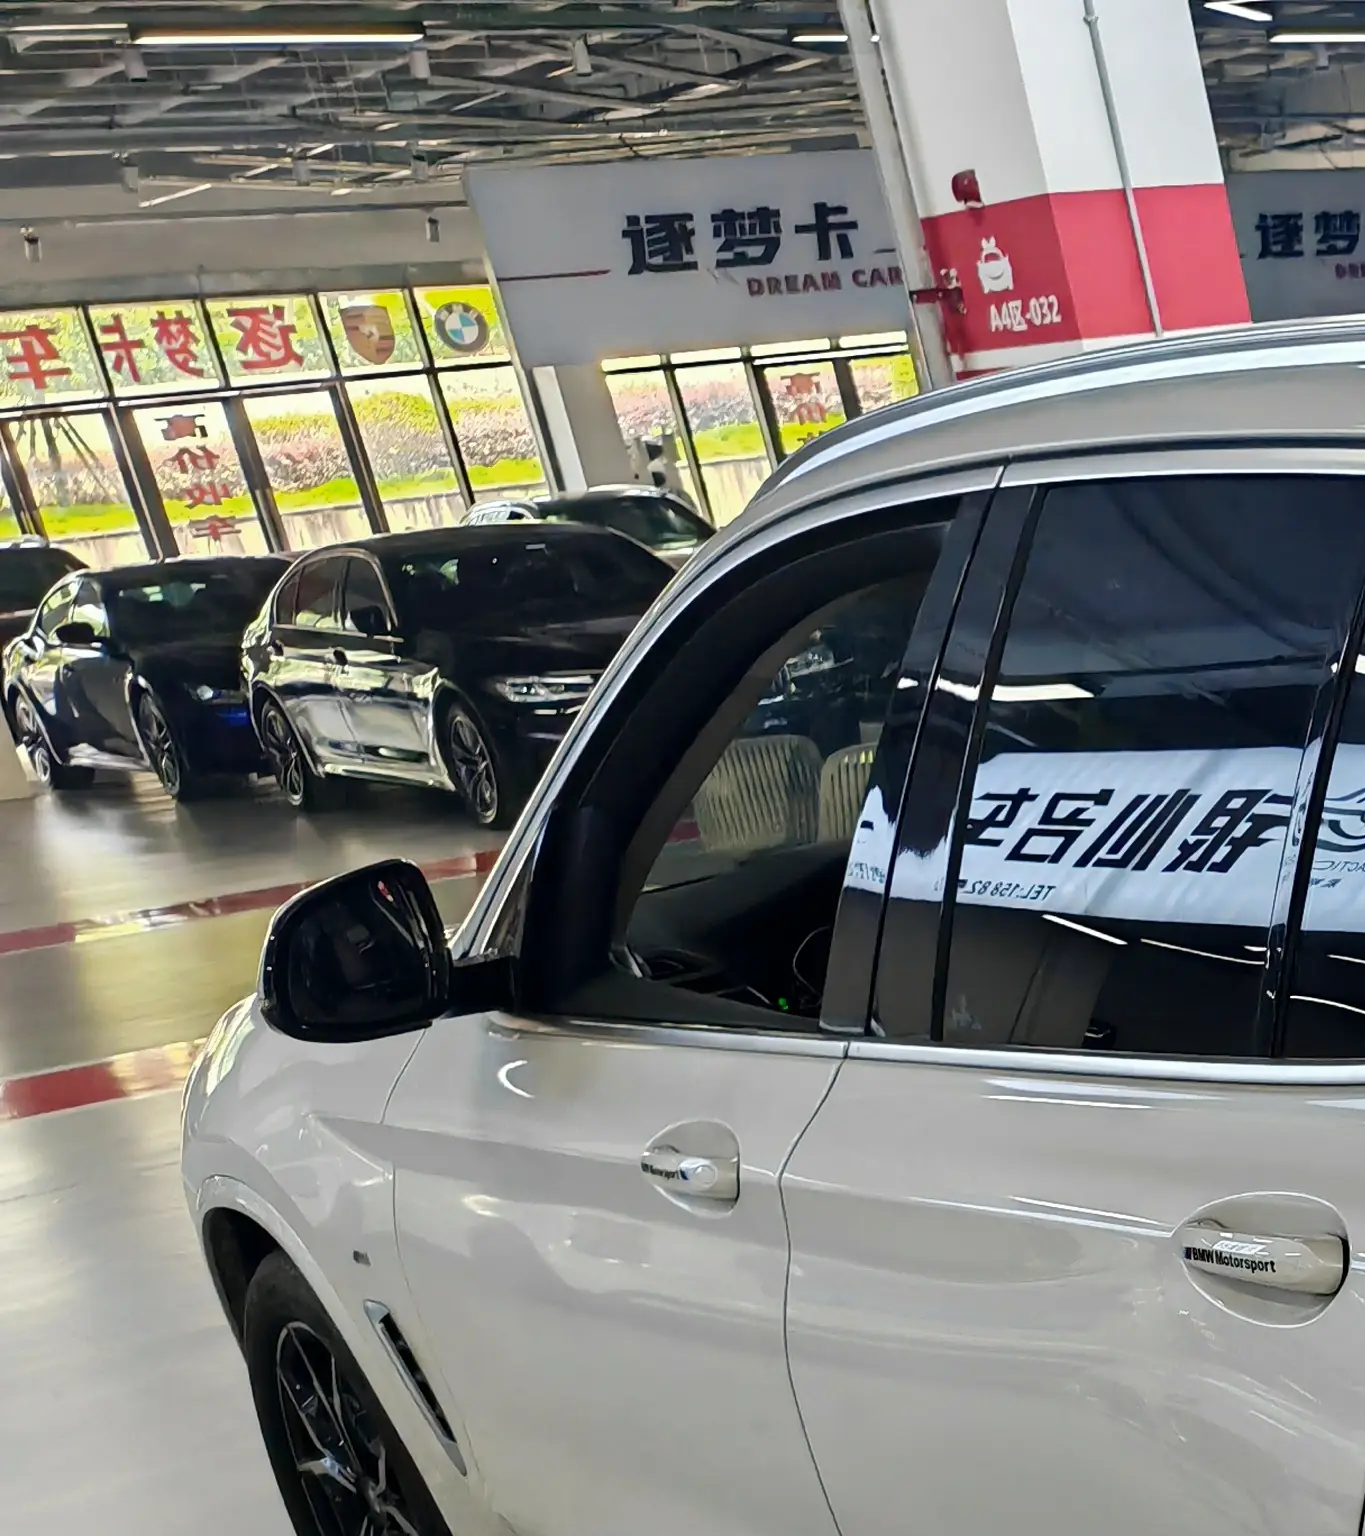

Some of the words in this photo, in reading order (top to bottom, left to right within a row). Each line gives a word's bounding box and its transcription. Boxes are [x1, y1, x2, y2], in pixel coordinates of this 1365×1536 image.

[621, 201, 858, 275] 逐梦卡
[746, 270, 842, 297] DREAM
[988, 294, 1062, 333] A4区-032
[1192, 1246, 1214, 1264] BMW
[1215, 1250, 1277, 1274] Motorsport
